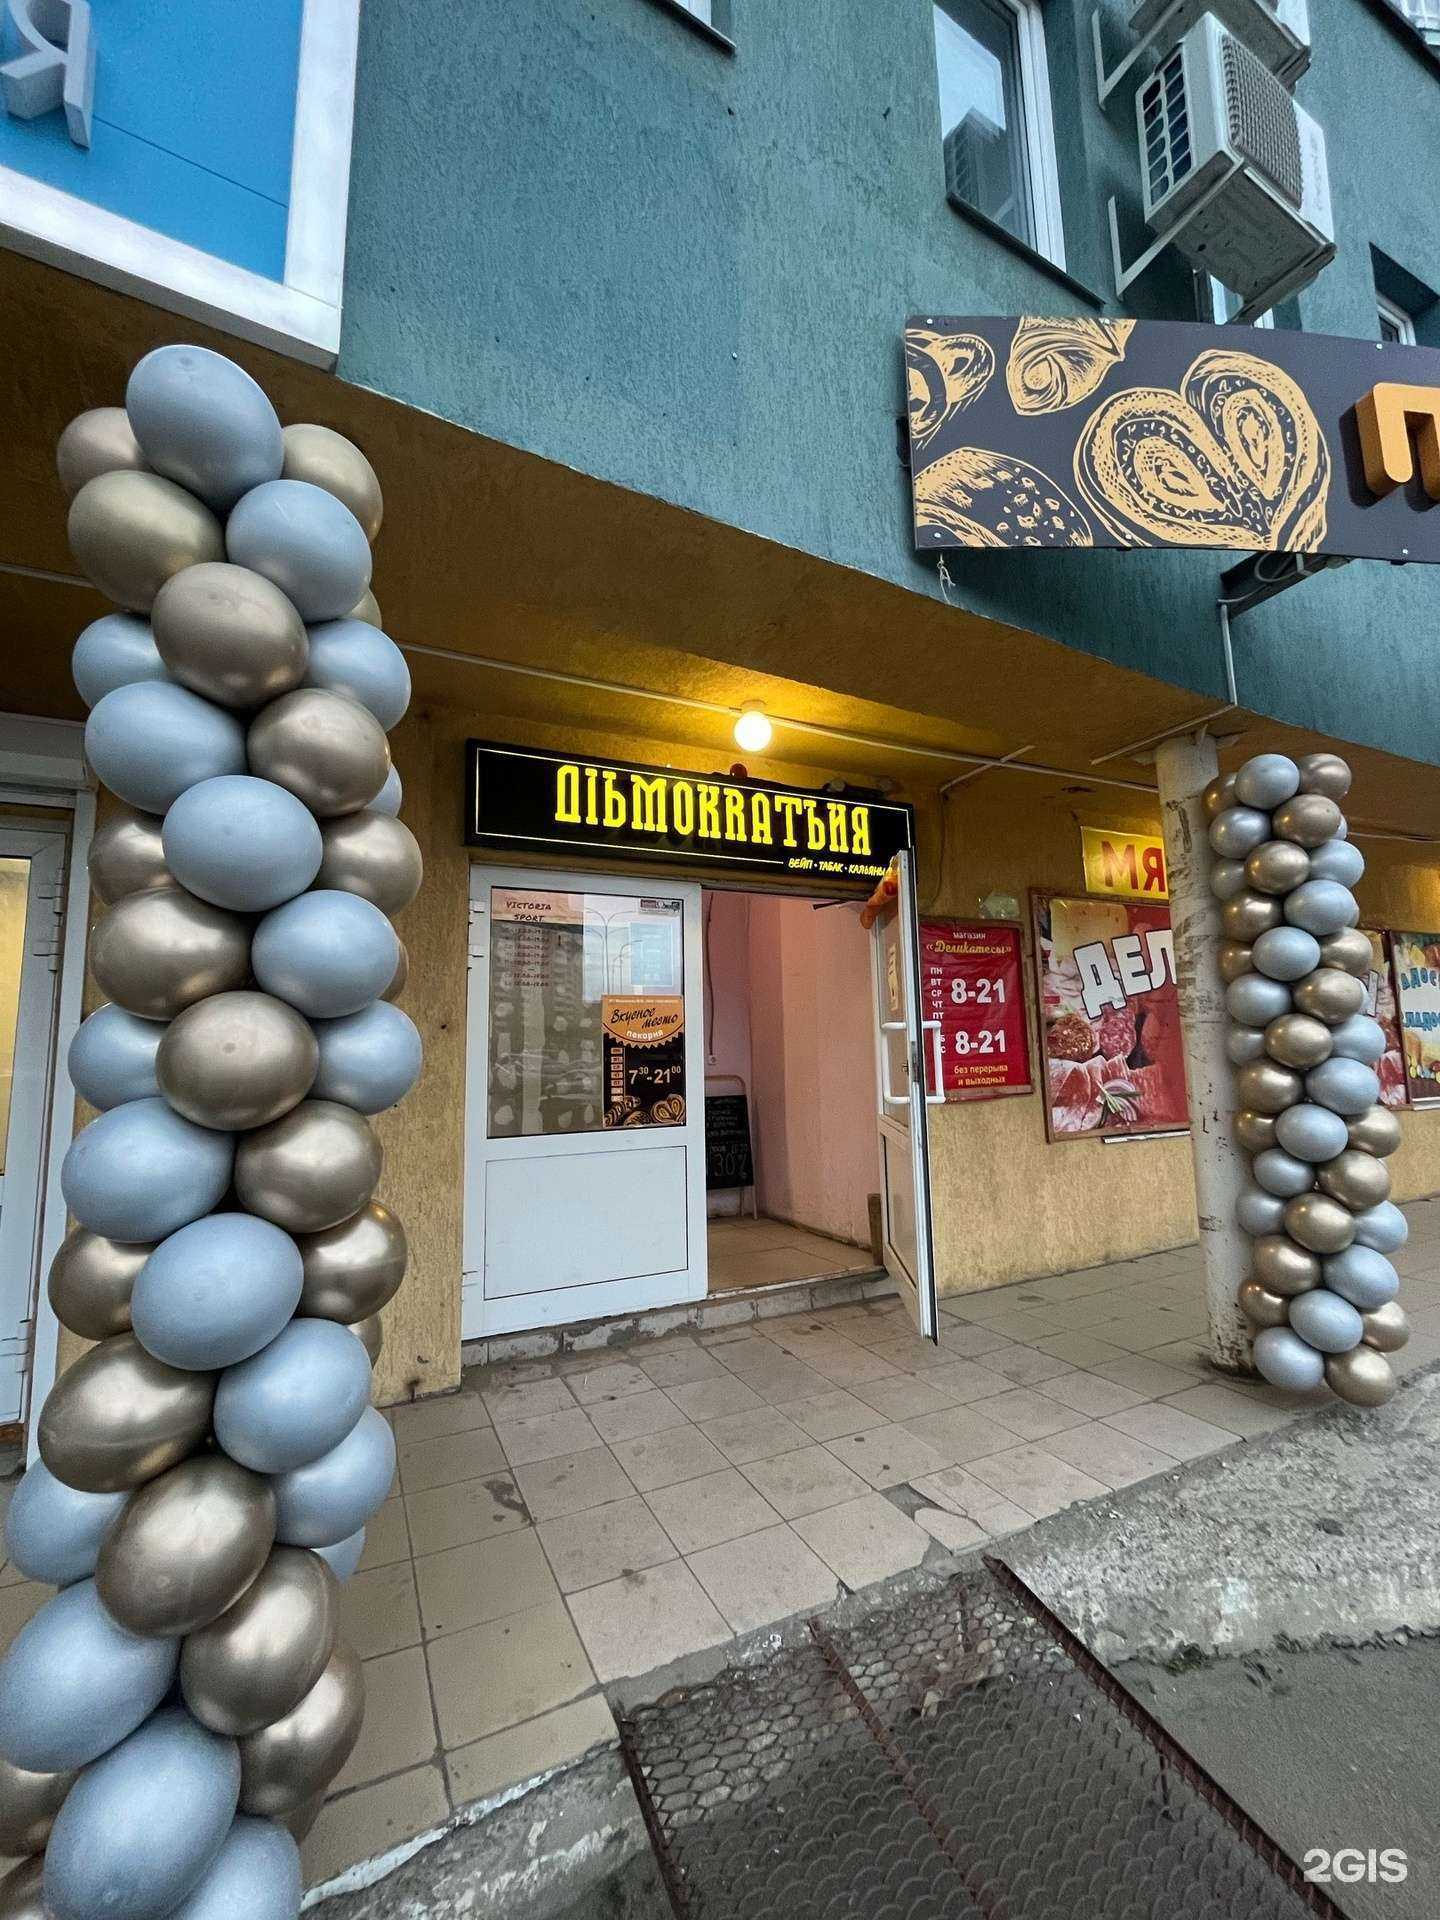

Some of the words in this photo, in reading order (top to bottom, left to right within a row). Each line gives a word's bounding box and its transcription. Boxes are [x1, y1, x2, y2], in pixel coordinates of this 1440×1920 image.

[788, 857, 813, 869] ВЕЙП
[818, 861, 844, 873] ТАБАК
[506, 901, 552, 911] VICTORIA
[513, 914, 545, 922] SPORT
[951, 978, 1005, 1004] 8-21
[641, 1013, 679, 1029] место
[955, 1029, 1006, 1054] 8-21
[954, 1065, 968, 1074] без
[970, 1064, 1008, 1074] перерыва
[965, 1076, 1006, 1085] выходных
